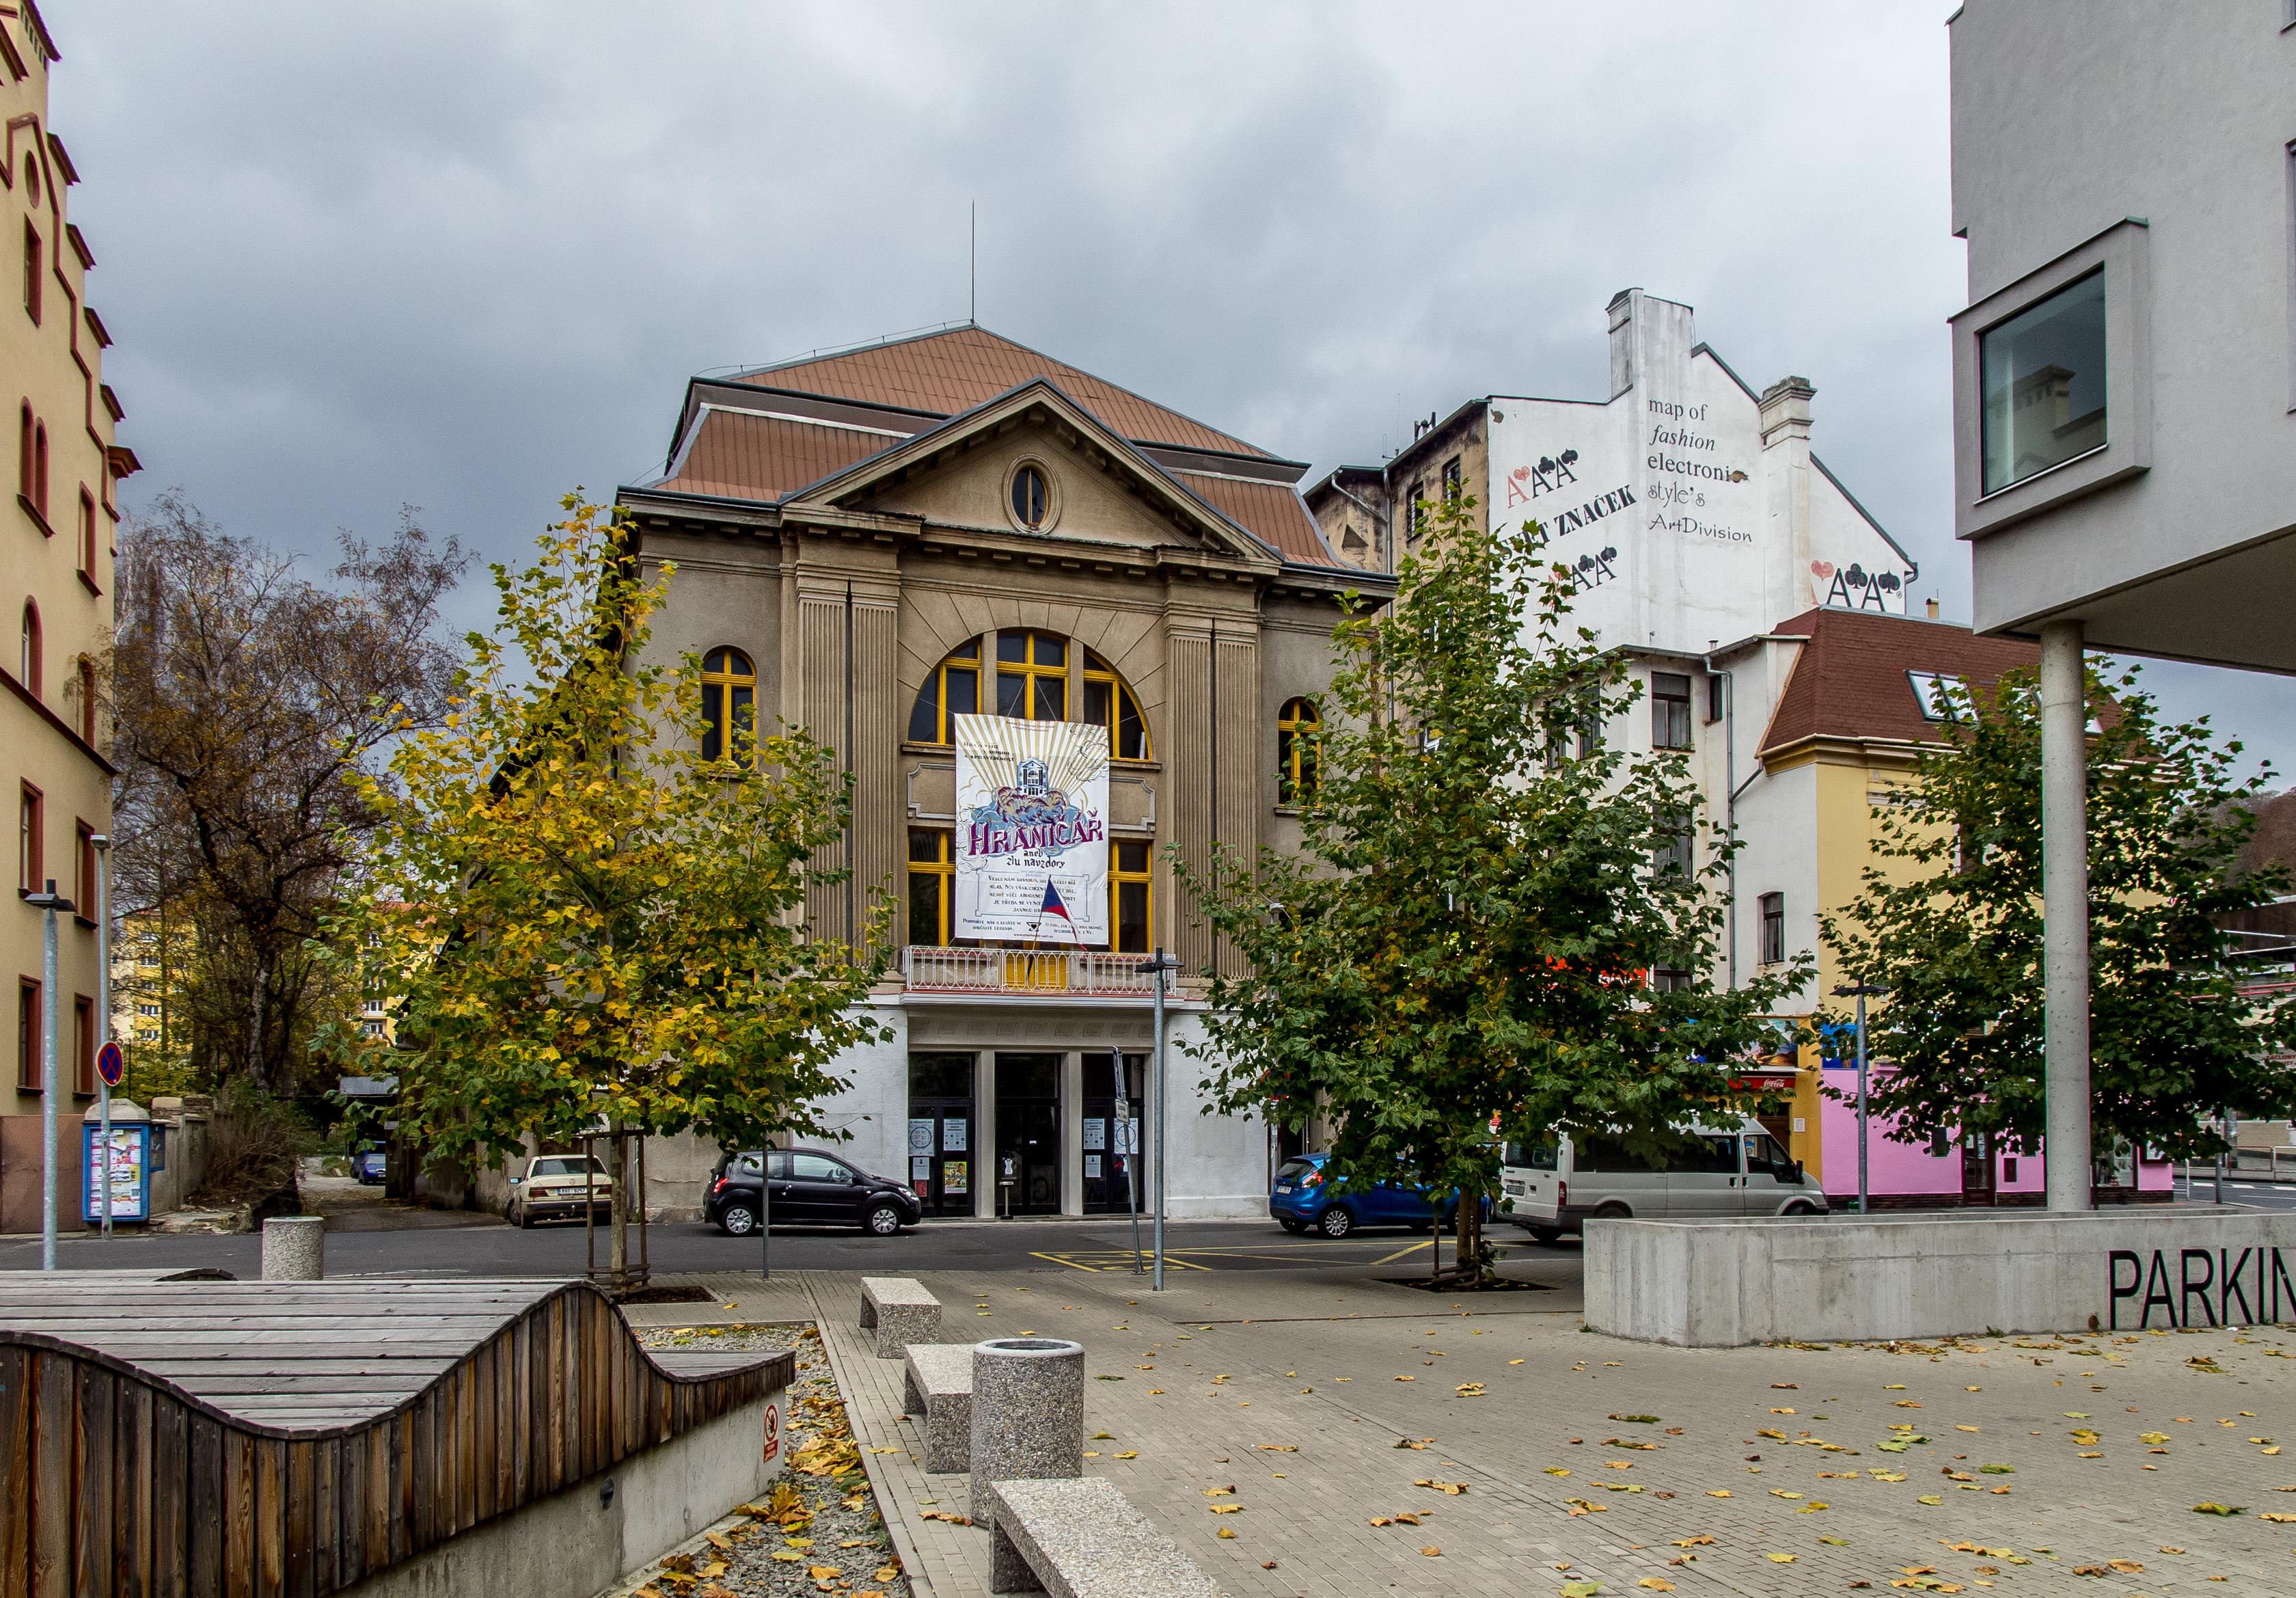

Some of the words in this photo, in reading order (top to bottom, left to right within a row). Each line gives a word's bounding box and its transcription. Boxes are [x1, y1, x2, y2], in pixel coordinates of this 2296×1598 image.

[1649, 399, 1684, 420] map
[1689, 404, 1708, 420] of
[1649, 424, 1715, 451] fashion
[1648, 452, 1740, 483] electroni
[1553, 484, 1637, 537] ZNAČEK
[1649, 513, 1752, 542] ArtDivision
[968, 811, 1103, 856] HRANIČÁŘ
[1007, 856, 1021, 866] zlu
[1024, 858, 1065, 869] navzdory
[1024, 849, 1043, 858] aneb
[2109, 1247, 2296, 1330] PARKIN
